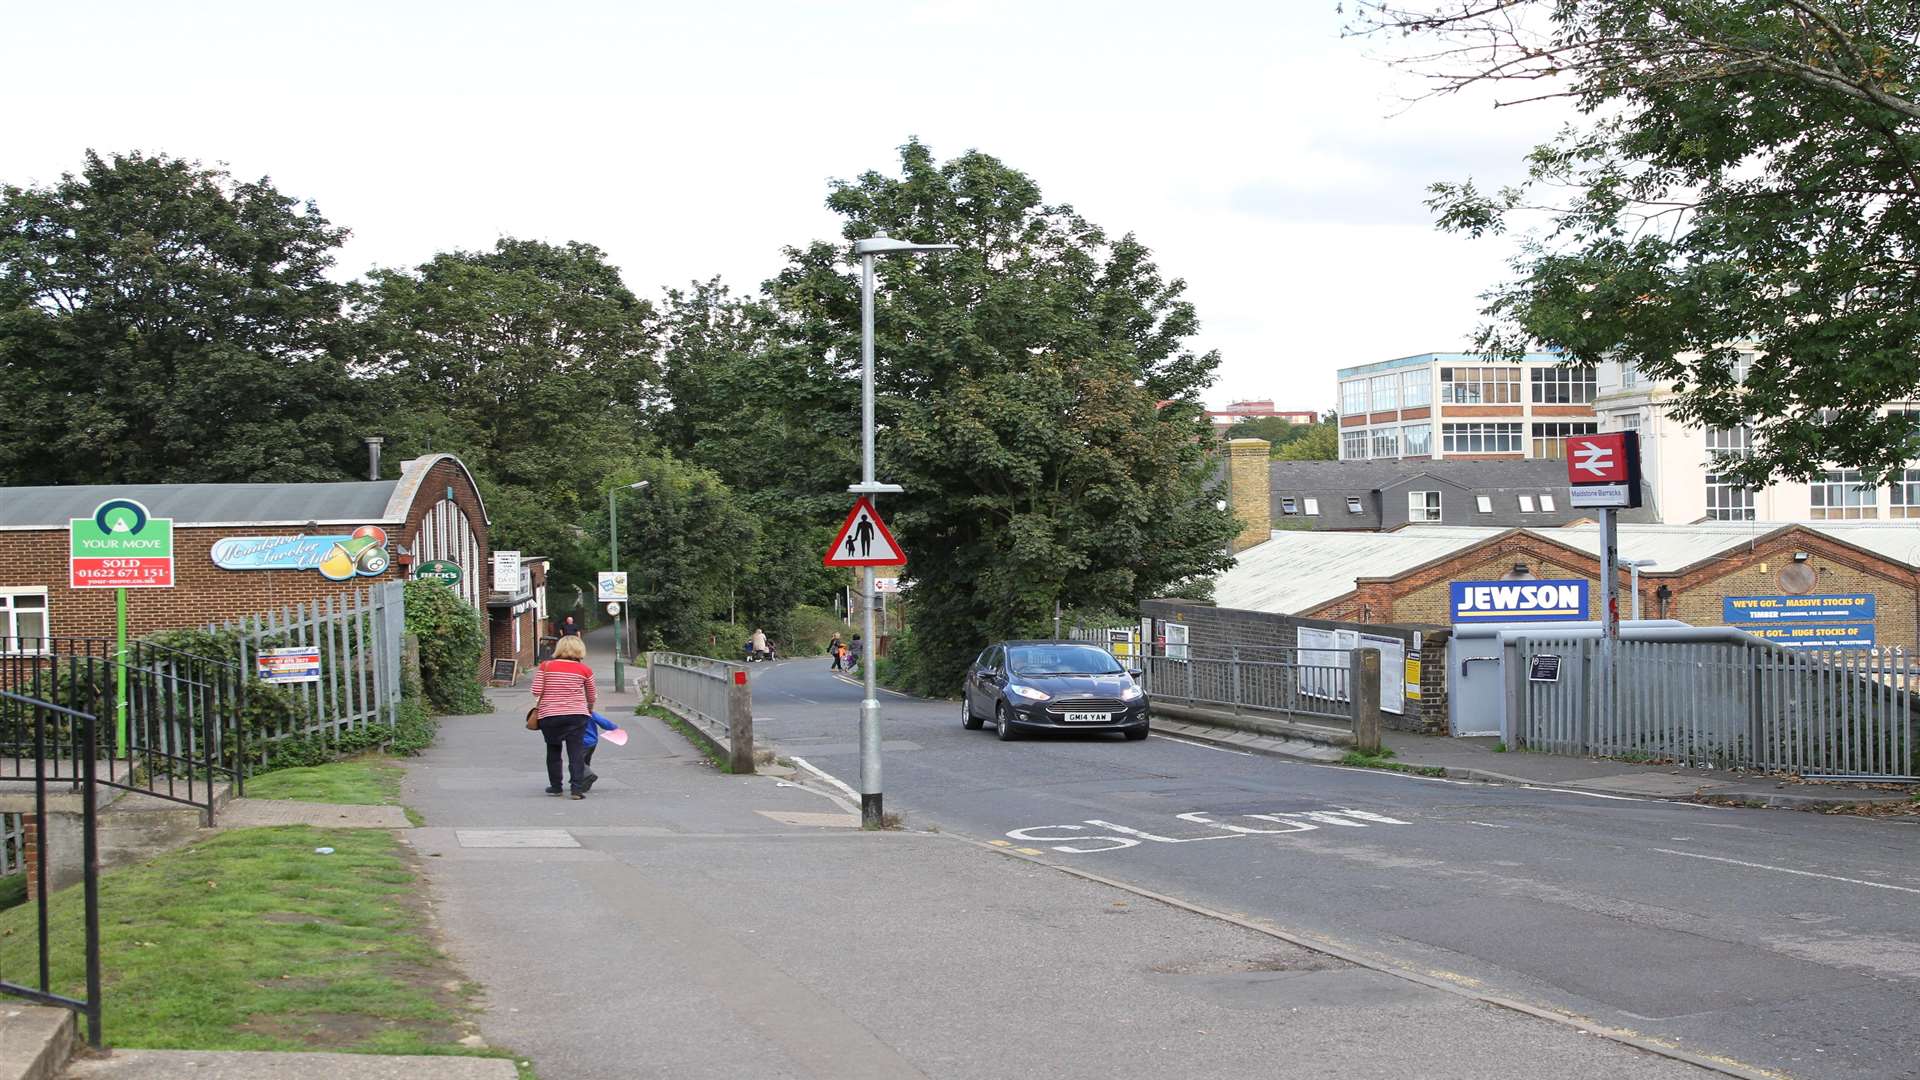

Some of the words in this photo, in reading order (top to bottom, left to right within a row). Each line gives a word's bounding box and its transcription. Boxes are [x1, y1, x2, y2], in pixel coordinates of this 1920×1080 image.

[82, 540, 119, 549] YOUR
[122, 539, 161, 549] MOVE
[102, 559, 140, 568] SOLD
[79, 569, 115, 577] 01622
[117, 568, 139, 577] 671
[143, 567, 164, 577] 151
[1457, 585, 1579, 611] JEWSON
[1733, 600, 1758, 608] WE'VE
[1786, 599, 1822, 607] MASSIVE
[1823, 598, 1853, 606] STOCKS
[1855, 598, 1866, 606] OF
[1750, 611, 1779, 619] TIMBER
[1792, 629, 1814, 637] HUGE
[1816, 628, 1846, 636] STOCKS
[1848, 628, 1859, 636] OF
[1006, 805, 1414, 853] SLOW
